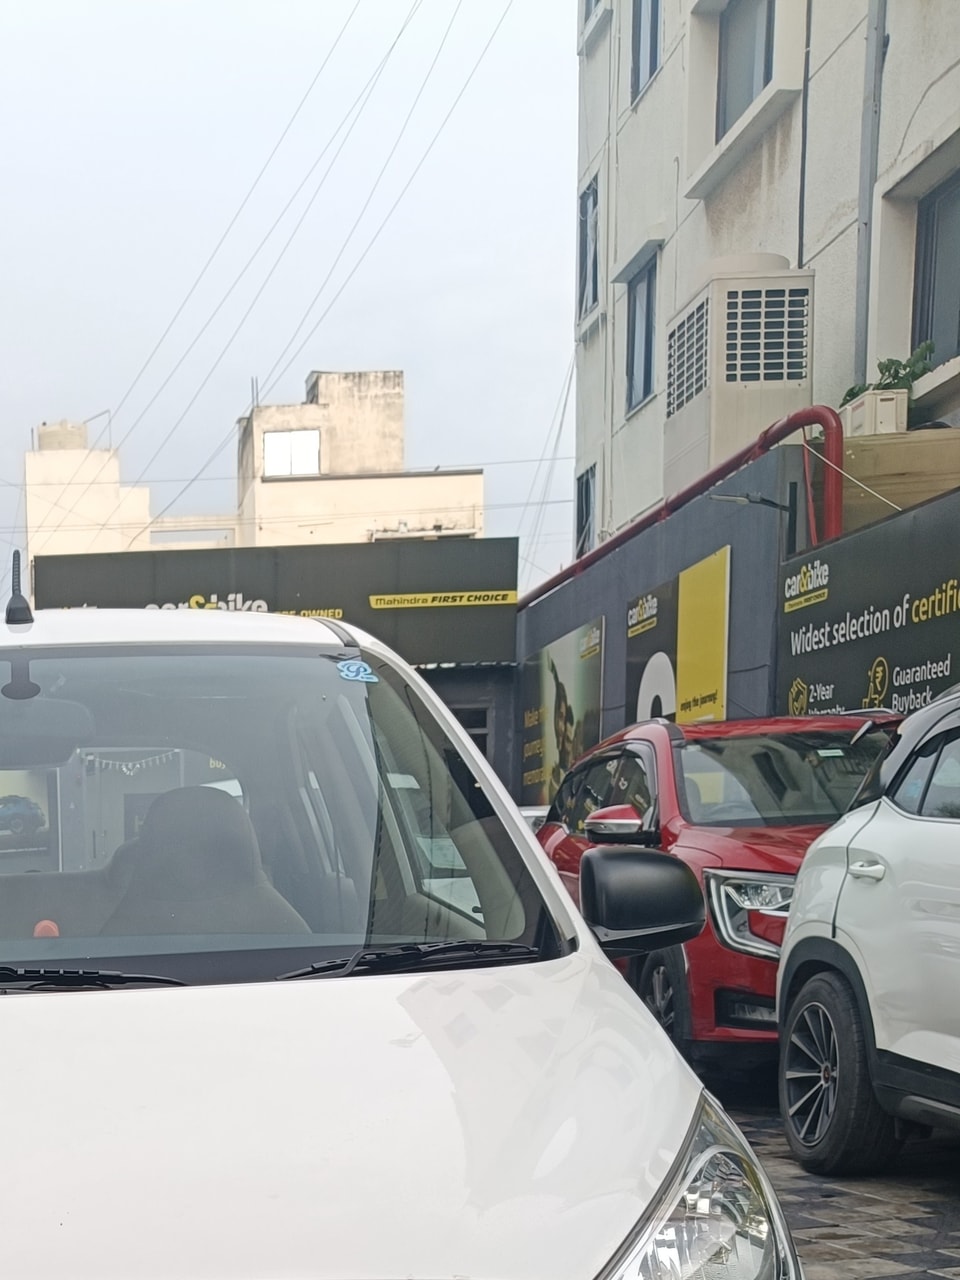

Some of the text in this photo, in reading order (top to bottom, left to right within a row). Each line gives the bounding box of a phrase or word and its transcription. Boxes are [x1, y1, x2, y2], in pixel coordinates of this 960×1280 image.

[785, 560, 829, 598] car&bike
[144, 593, 268, 613] &bike
[375, 593, 508, 606] Mahindra FIRST CHOICE
[791, 621, 831, 656] Widest
[833, 605, 890, 645] selection
[893, 594, 910, 628] of
[893, 653, 951, 687] Guaranteed
[809, 683, 835, 703] 2-Year
[892, 685, 933, 714] Buyback
